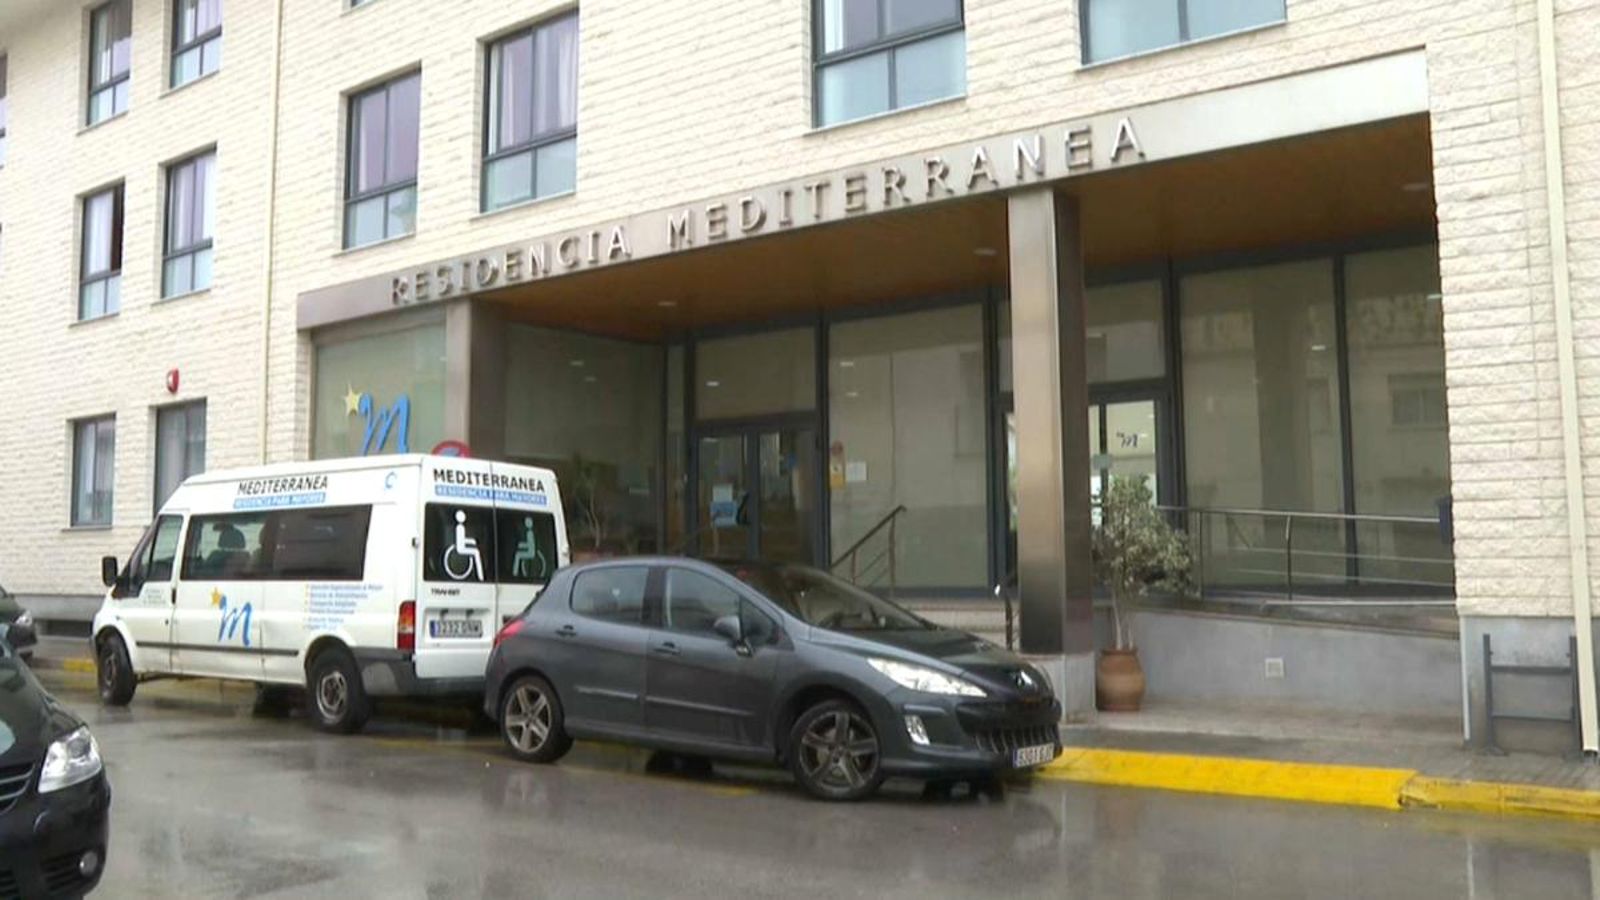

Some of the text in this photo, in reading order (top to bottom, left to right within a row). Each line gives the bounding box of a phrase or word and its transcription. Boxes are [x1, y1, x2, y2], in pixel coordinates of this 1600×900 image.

[391, 116, 1146, 305] RESIDENCIA MEDITERRANEA
[237, 476, 328, 495] MEDITERRANEA
[433, 469, 545, 492] MEDITERRANEA
